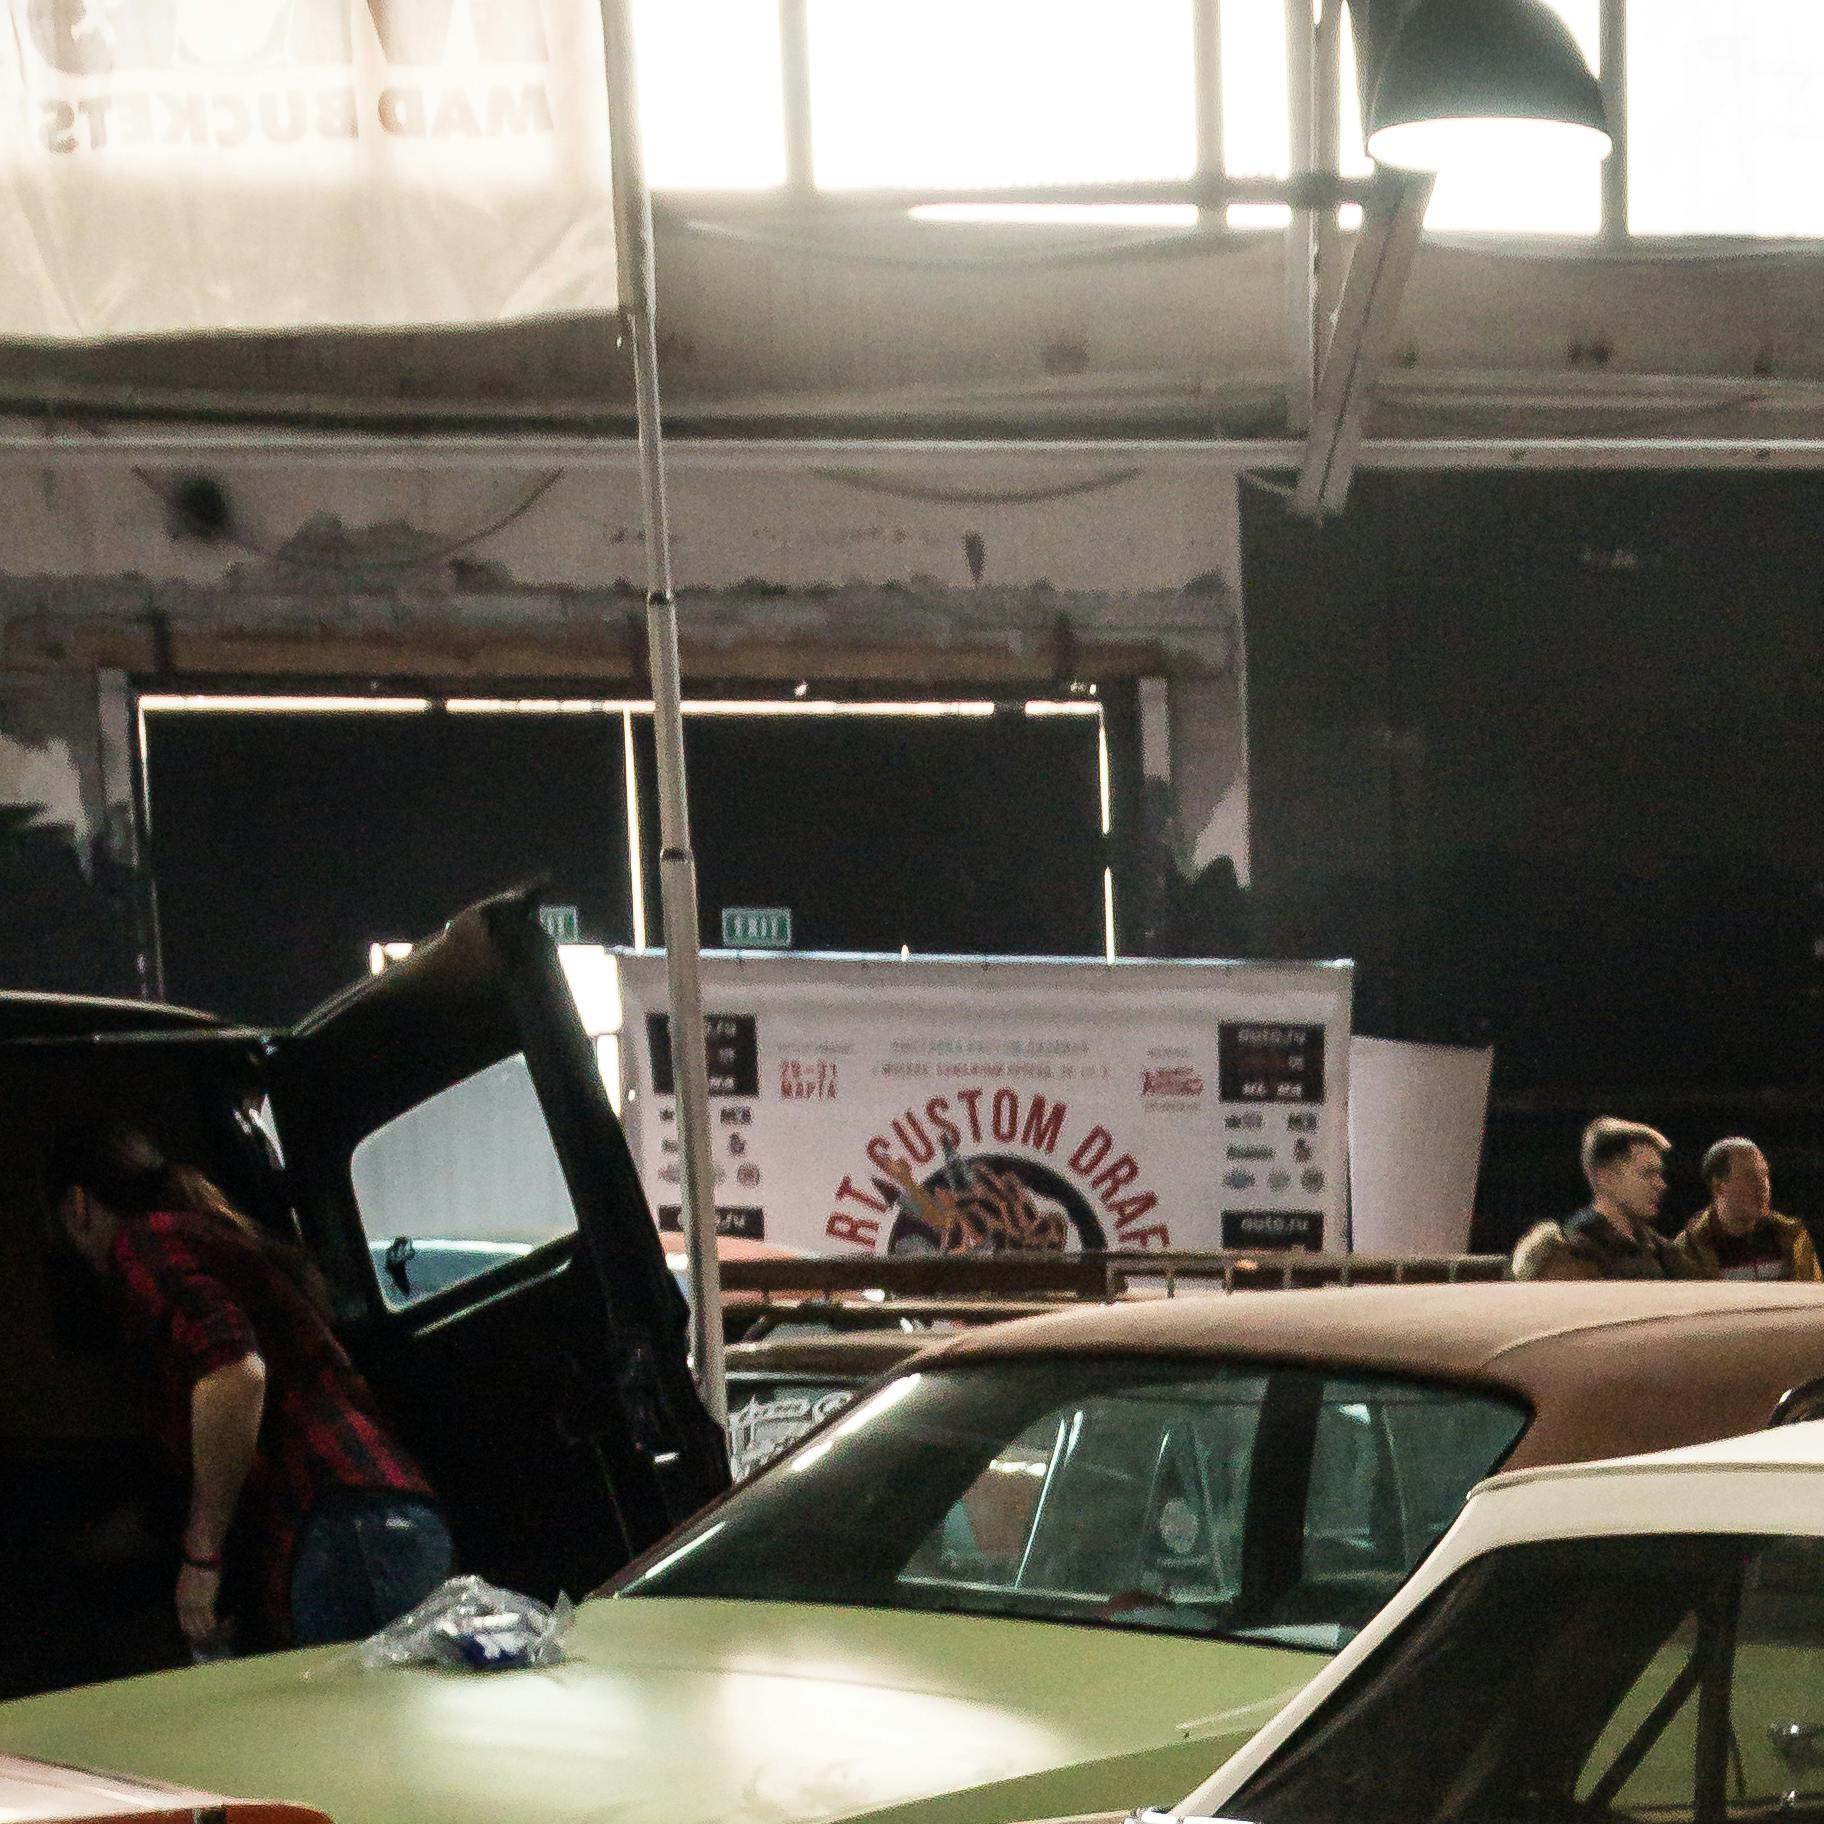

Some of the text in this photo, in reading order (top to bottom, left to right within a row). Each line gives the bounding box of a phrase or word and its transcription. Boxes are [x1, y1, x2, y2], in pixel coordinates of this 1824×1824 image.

[825, 1087, 1171, 1250] RT CUSTOM DRAF
